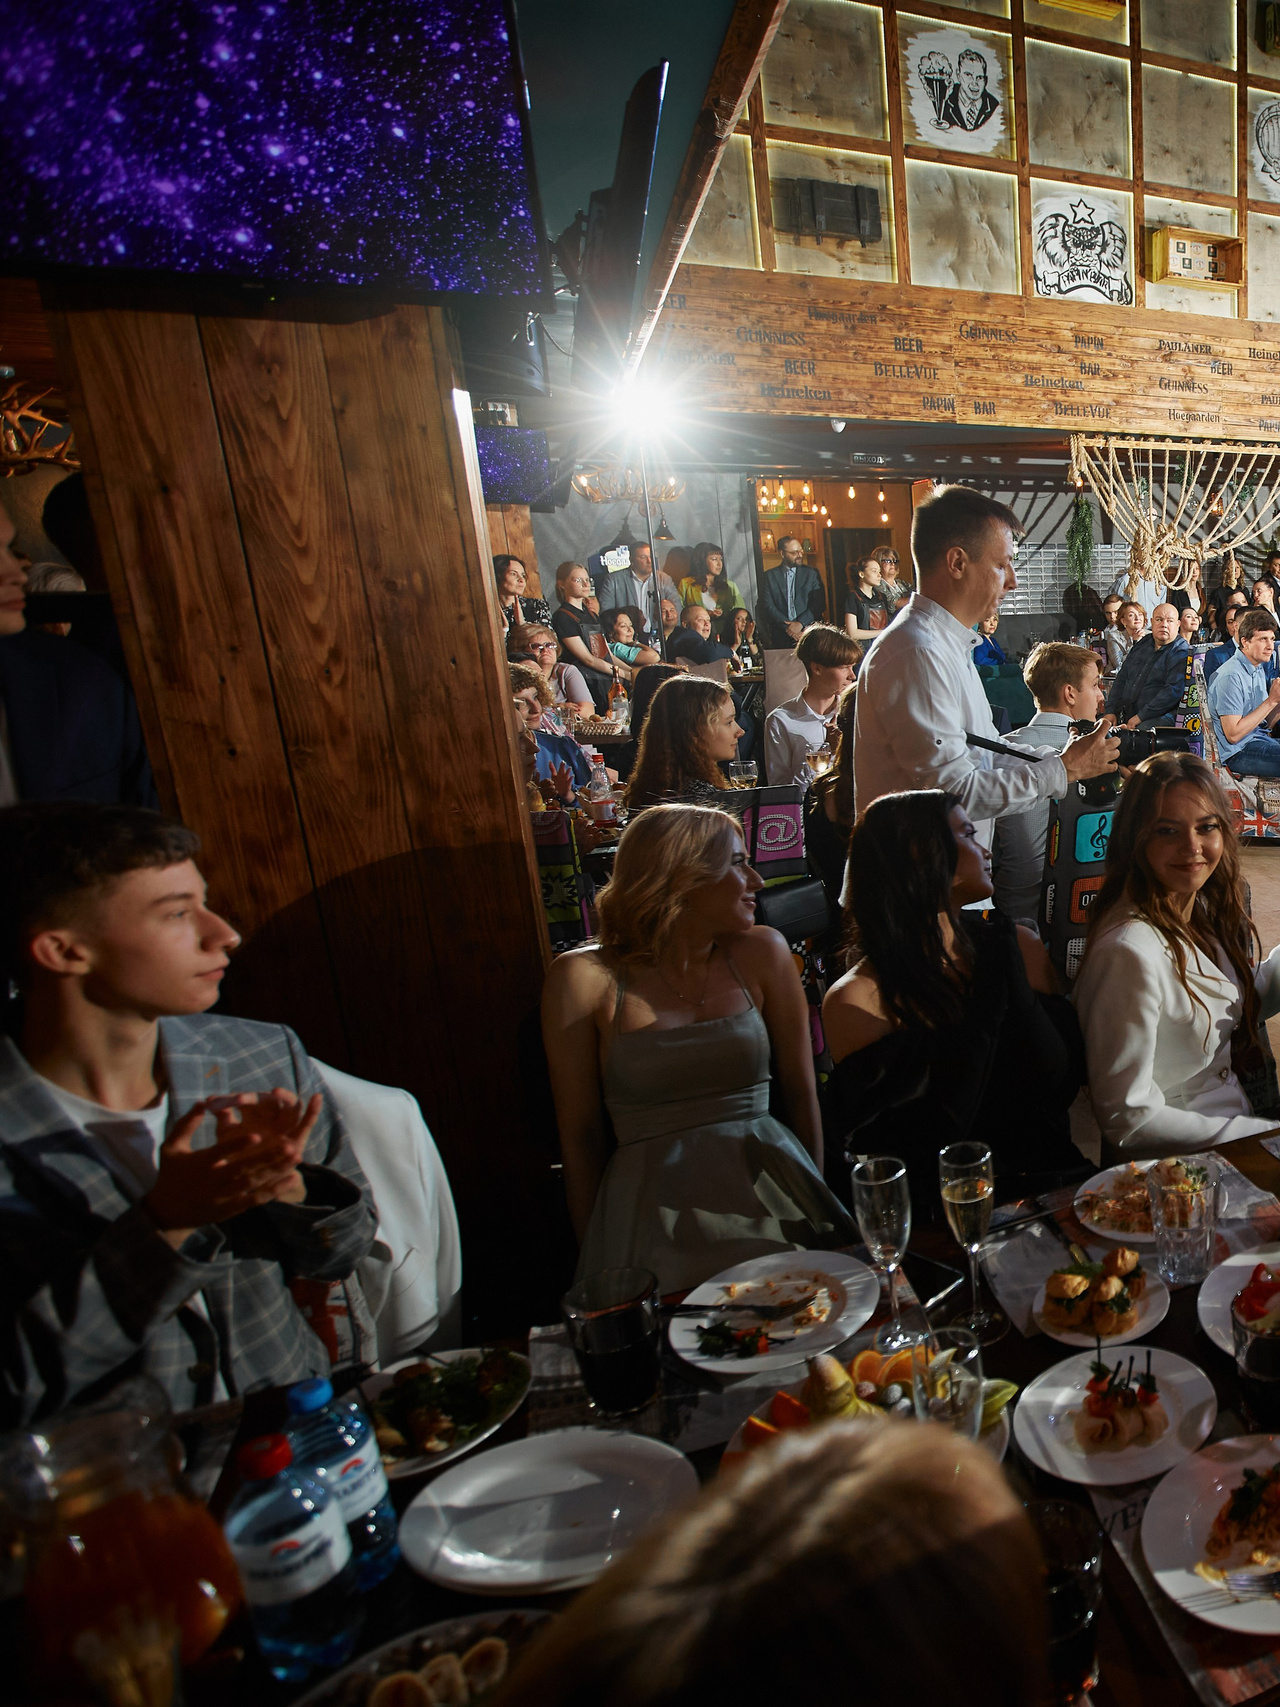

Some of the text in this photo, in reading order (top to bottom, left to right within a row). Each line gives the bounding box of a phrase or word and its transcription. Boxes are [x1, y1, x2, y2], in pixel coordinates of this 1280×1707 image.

[736, 326, 806, 346] GUINNESS
[1074, 335, 1104, 351] PAPIN
[894, 337, 923, 353] BEER
[1158, 339, 1212, 355] PAULANER
[785, 359, 816, 376] BEER
[1080, 362, 1100, 376] BAR
[1211, 361, 1233, 376] BEER
[760, 379, 832, 401] Heineken
[1024, 373, 1084, 391] Heineken
[1159, 376, 1209, 394] GUINNESS
[922, 396, 996, 415] PAPIN BAR
[1168, 408, 1220, 424] Hoegaarden
[853, 455, 882, 464] ВЫХОД
